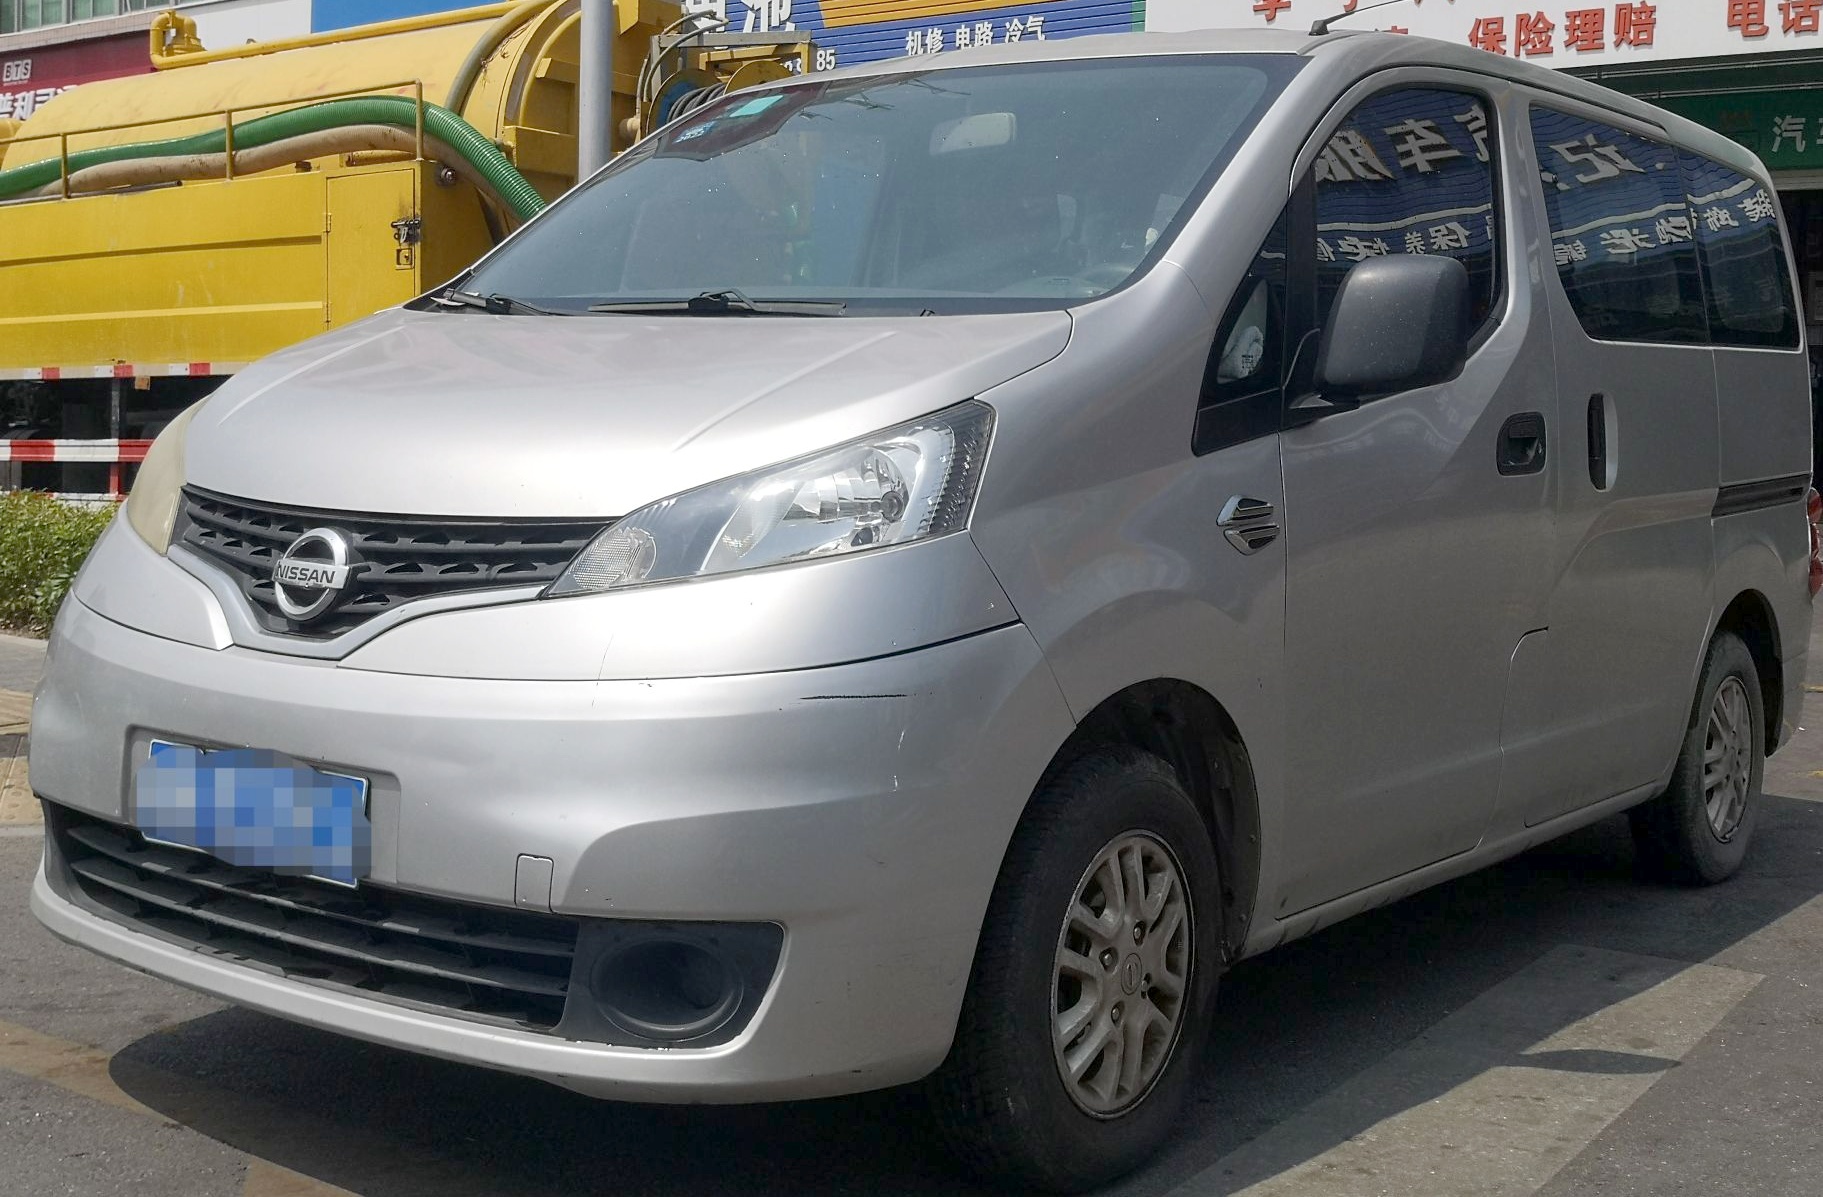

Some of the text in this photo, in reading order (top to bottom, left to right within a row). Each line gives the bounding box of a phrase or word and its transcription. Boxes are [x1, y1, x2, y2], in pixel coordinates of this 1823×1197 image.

[906, 16, 1045, 55] 机修 电路 冷气
[1468, 1, 1656, 56] 保险理赔
[1727, 0, 1823, 37] 电话
[4, 60, 30, 80] BTS
[276, 564, 335, 584] NISSAN
